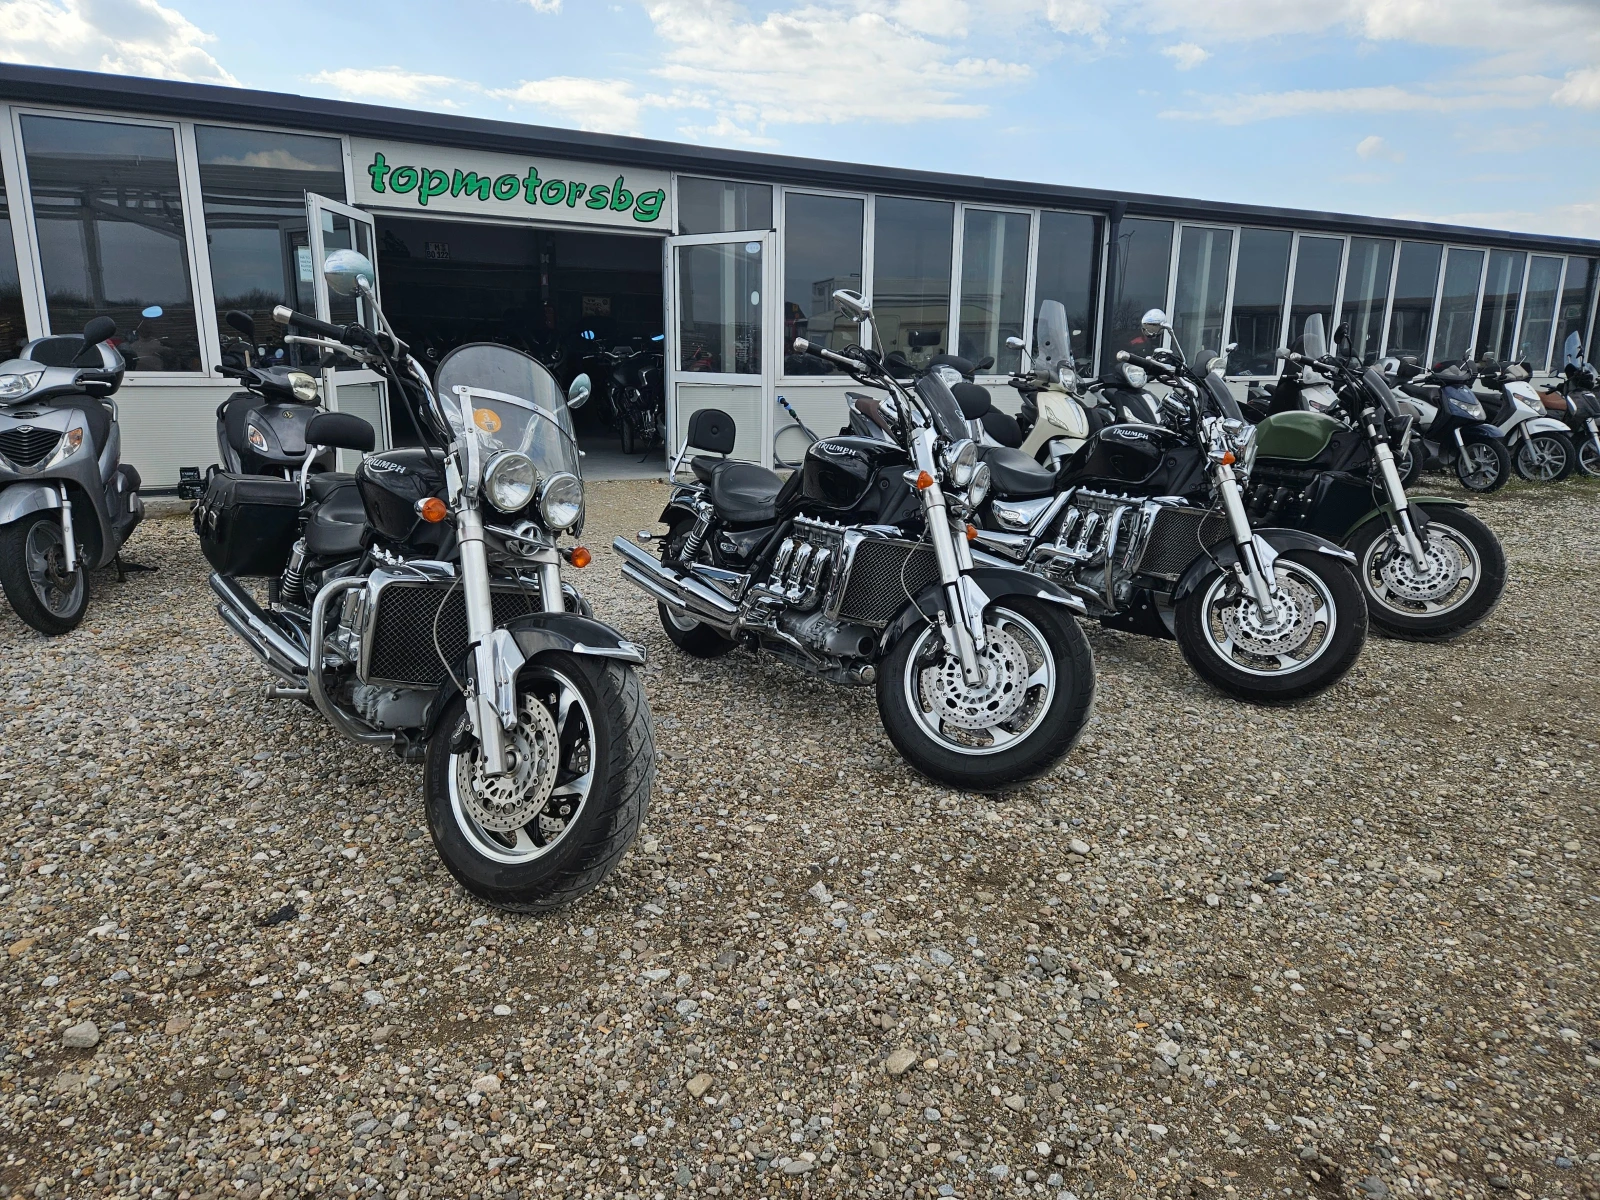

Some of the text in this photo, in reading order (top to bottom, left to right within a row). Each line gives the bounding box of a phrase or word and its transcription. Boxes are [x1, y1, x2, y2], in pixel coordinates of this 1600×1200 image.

[368, 152, 666, 222] topmotorsbg
[1113, 427, 1149, 440] TRIUMPH
[818, 441, 857, 456] TRIUMPH
[363, 456, 407, 474] TRIUMPH
